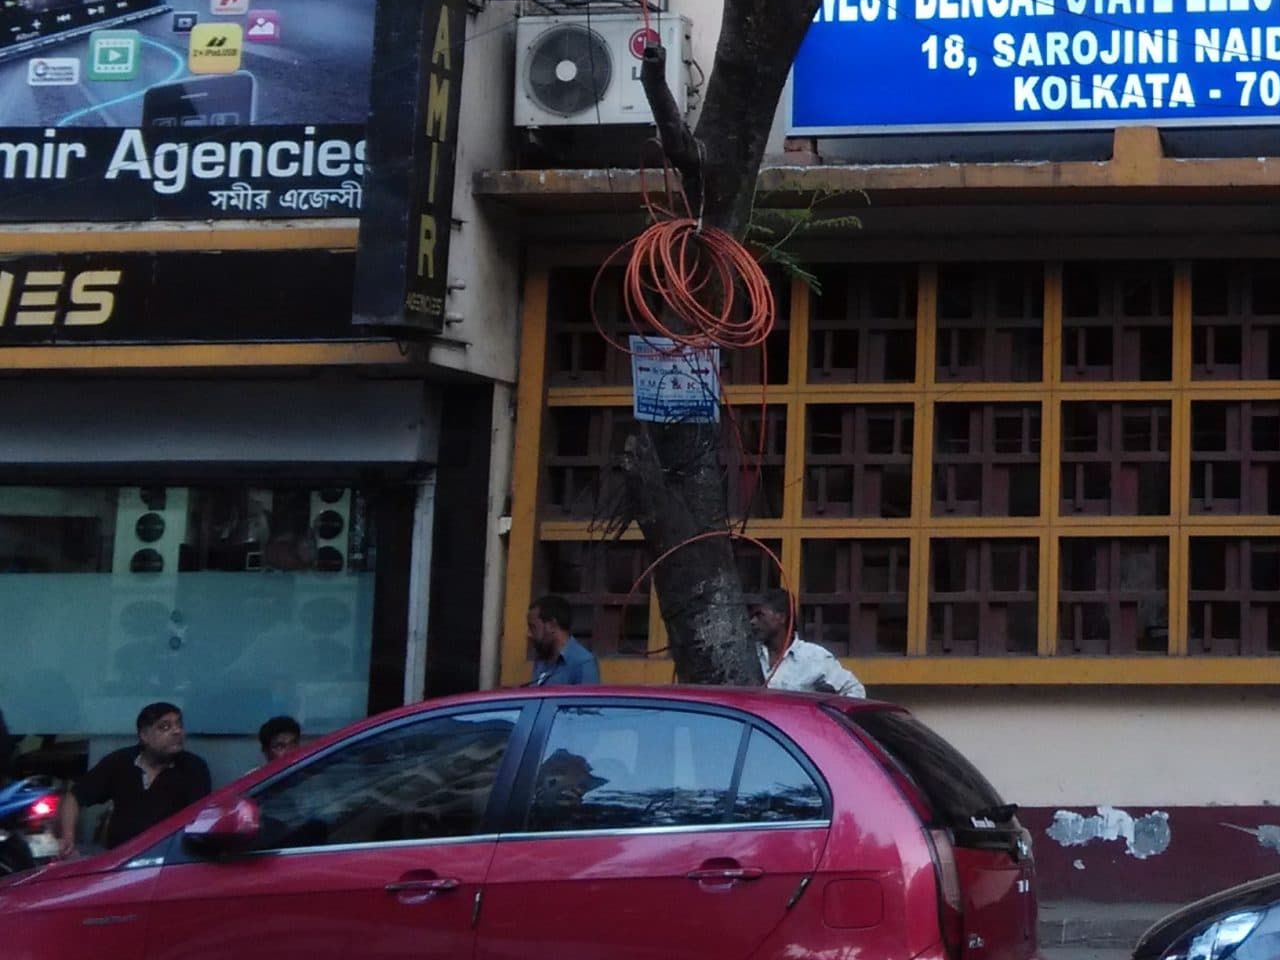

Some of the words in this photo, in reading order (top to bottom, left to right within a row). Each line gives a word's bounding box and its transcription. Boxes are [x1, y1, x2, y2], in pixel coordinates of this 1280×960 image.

[921, 34, 978, 76] 18,
[992, 28, 1179, 69] SAROJINI
[1013, 73, 1196, 111] KOLKATA
[1208, 88, 1222, 100] -
[208, 183, 271, 211] সমীর
